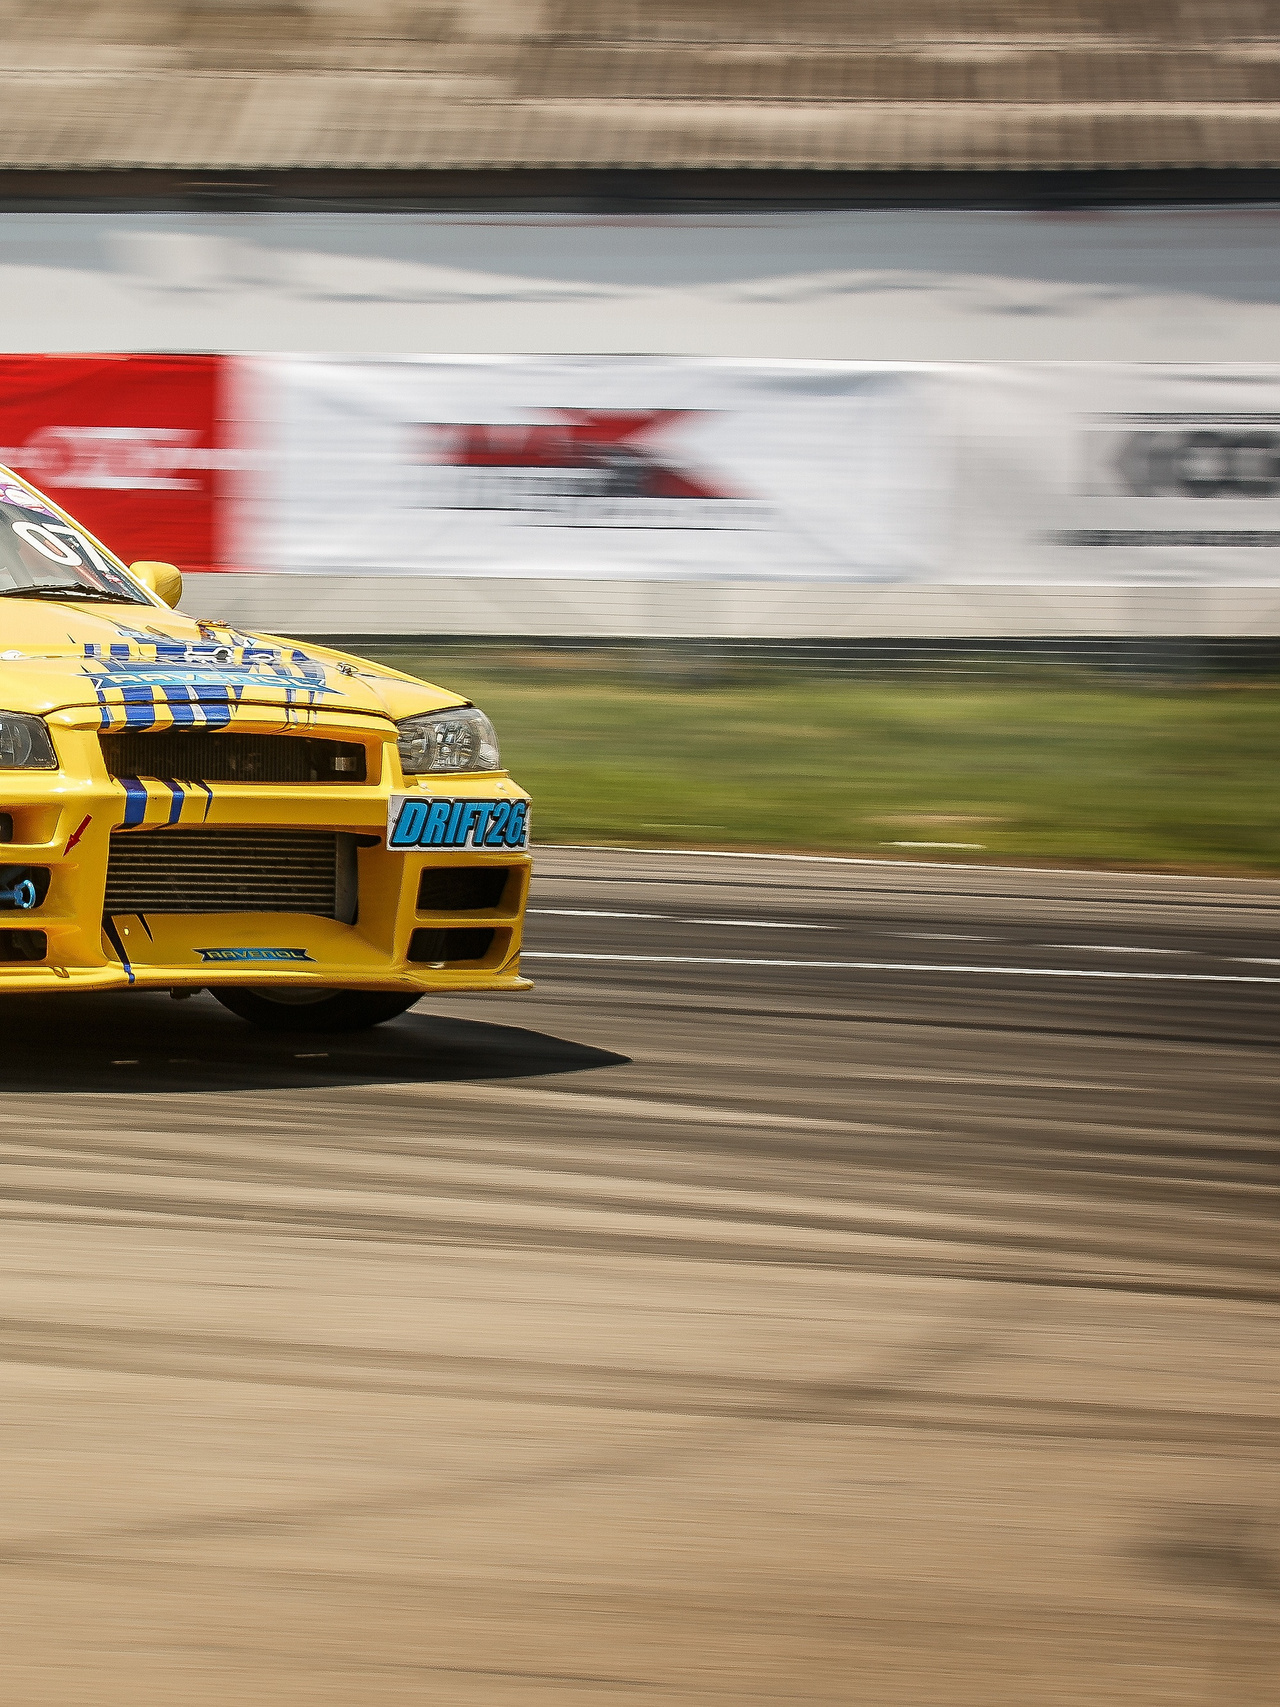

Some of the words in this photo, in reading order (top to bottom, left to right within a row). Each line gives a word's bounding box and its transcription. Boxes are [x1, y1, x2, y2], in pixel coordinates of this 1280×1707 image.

[11, 521, 110, 572] 07
[104, 674, 322, 689] RAVENOL
[206, 950, 304, 960] RAVENOL
